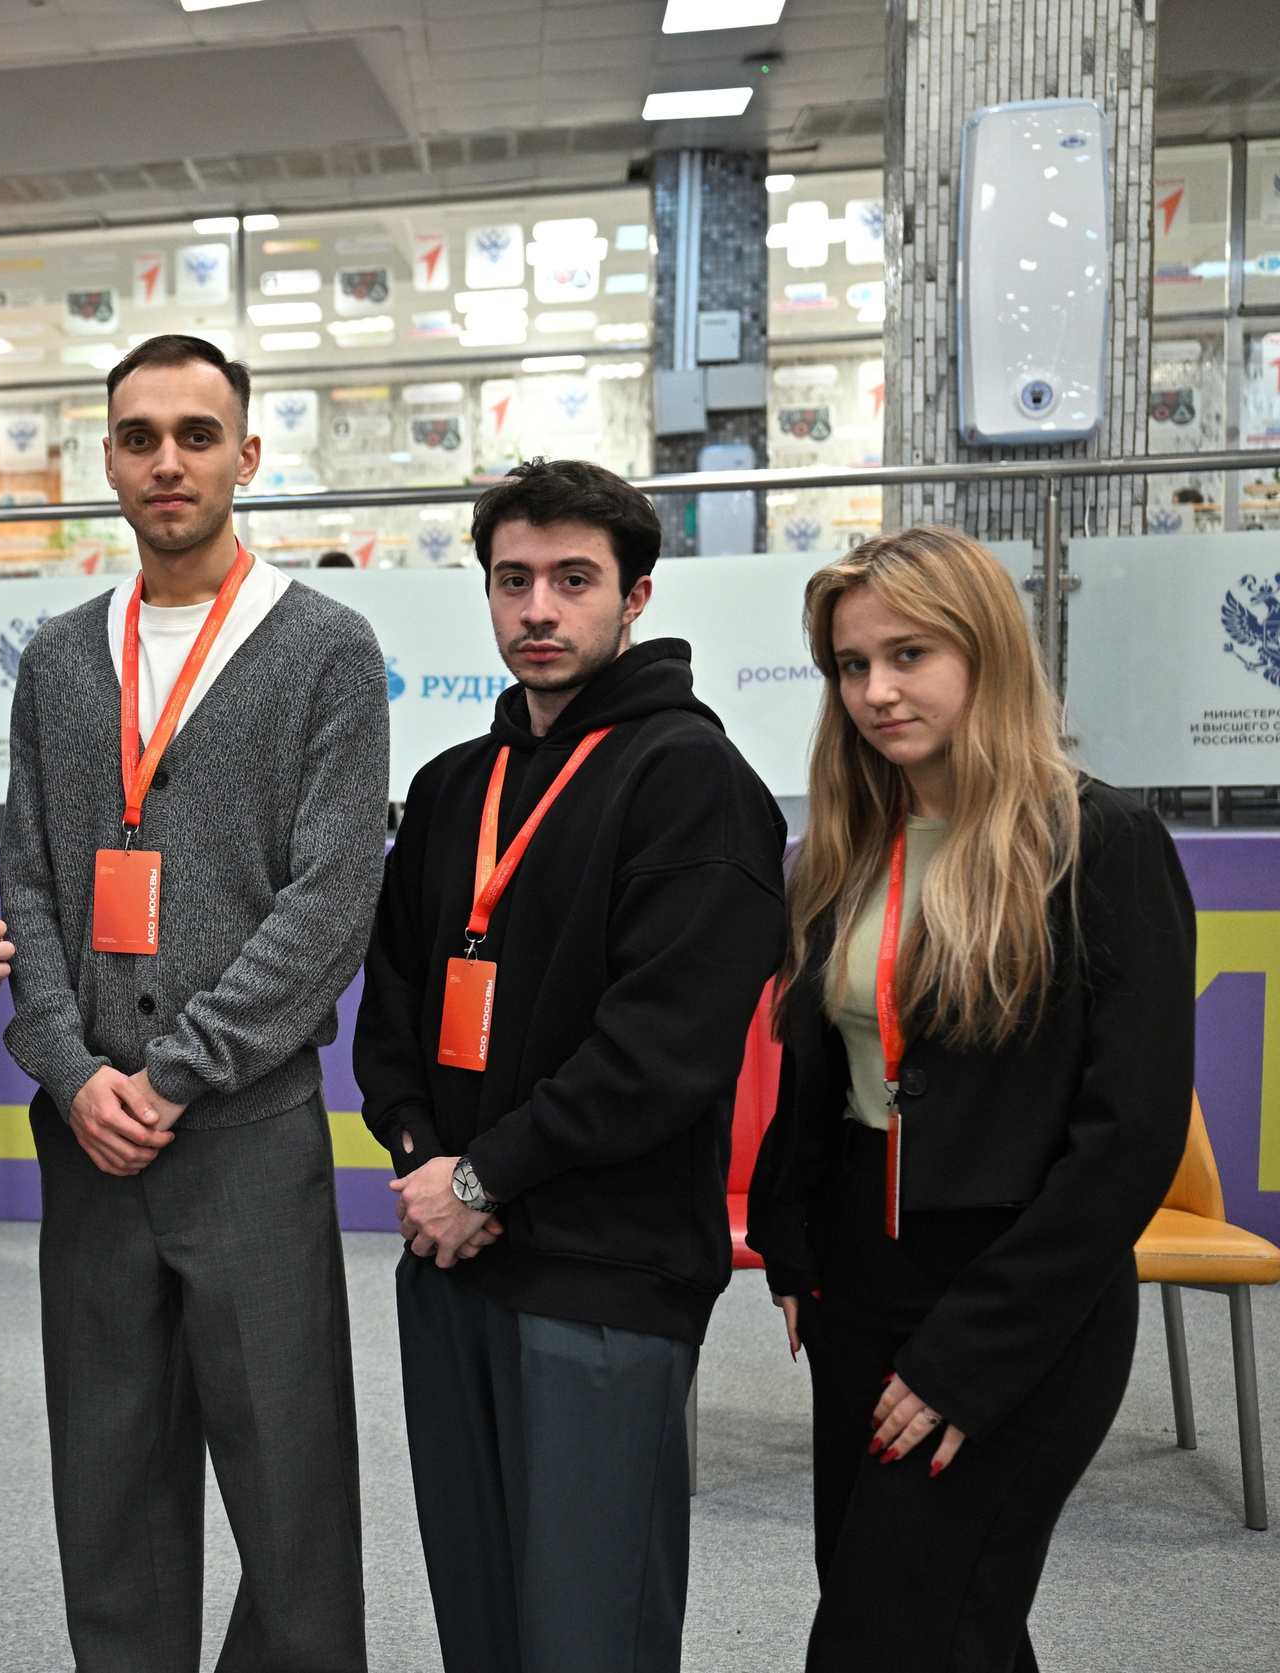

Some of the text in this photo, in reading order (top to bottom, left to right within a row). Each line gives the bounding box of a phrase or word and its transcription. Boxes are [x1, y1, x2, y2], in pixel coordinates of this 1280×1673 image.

[421, 675, 509, 703] РУДН
[1190, 723, 1199, 732] И
[1202, 721, 1270, 732] ВЫСШЕГО
[147, 868, 158, 945] АСО МОСКВЫ
[479, 979, 494, 1060] АСО МОСКВЫ
